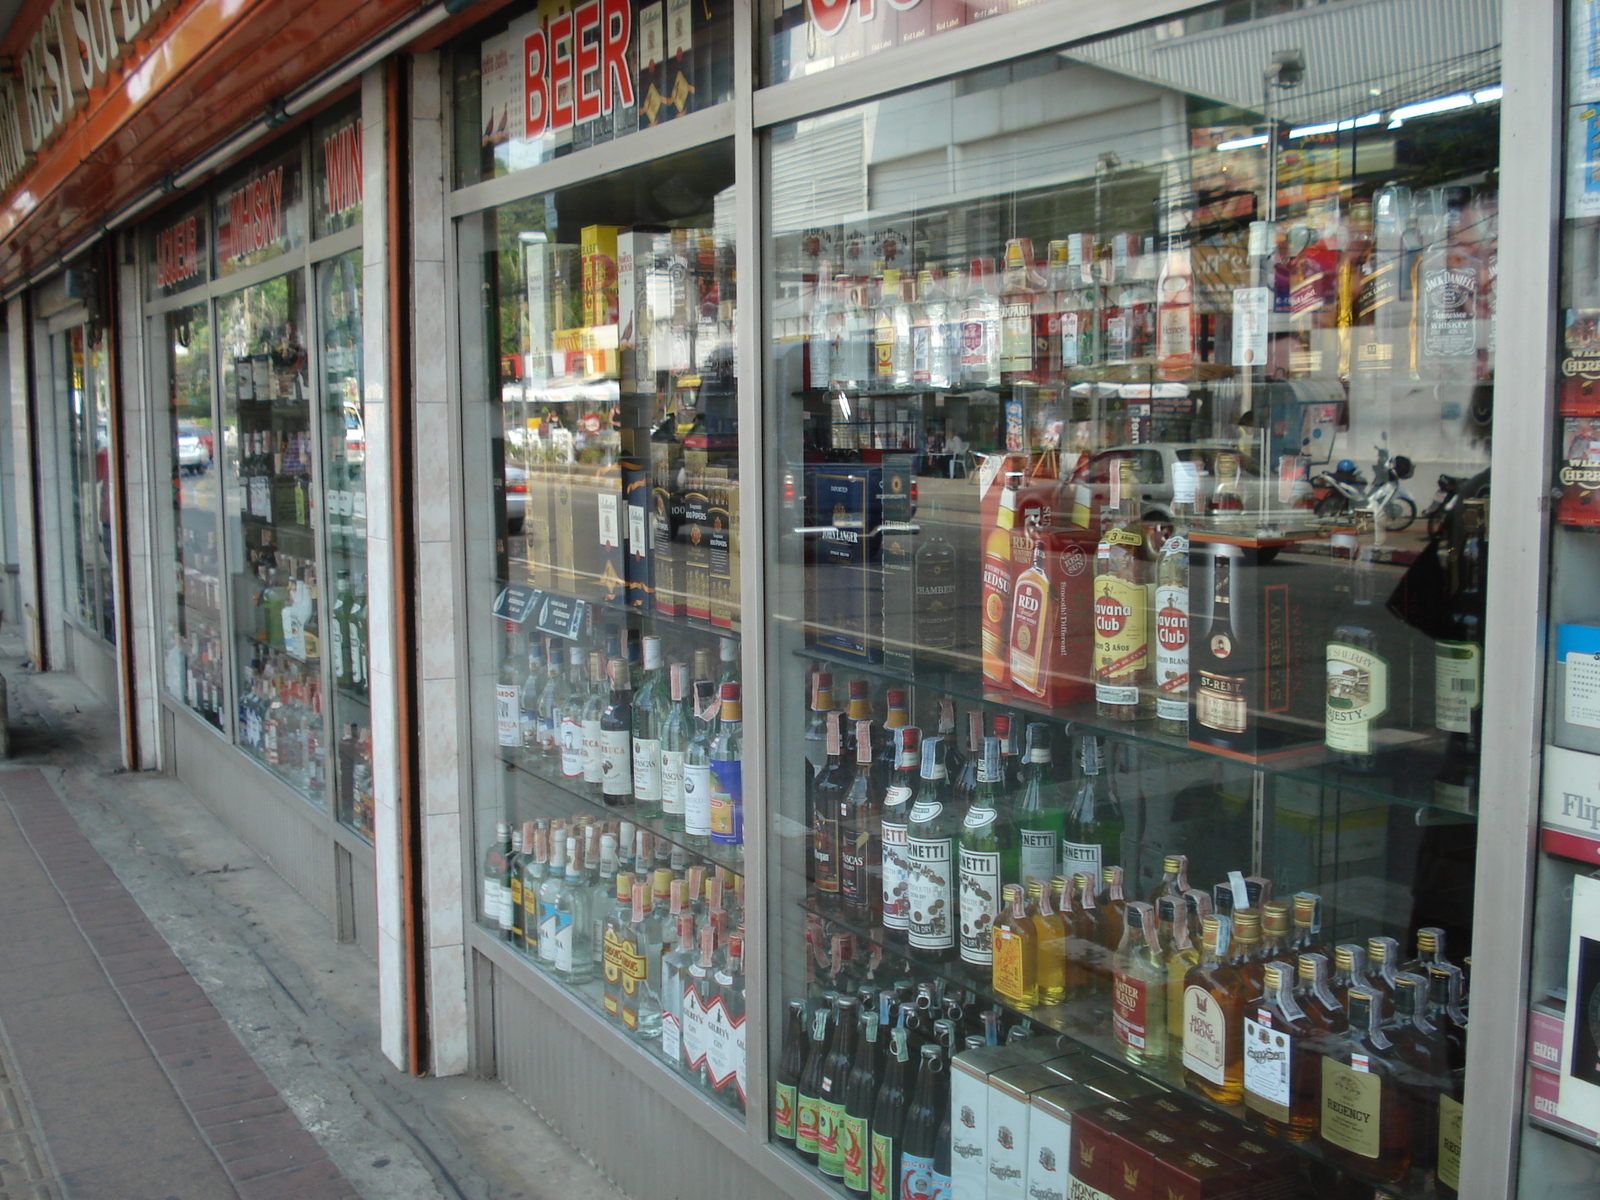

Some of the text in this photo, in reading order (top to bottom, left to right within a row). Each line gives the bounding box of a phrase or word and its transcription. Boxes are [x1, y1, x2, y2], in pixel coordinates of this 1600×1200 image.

[21, 0, 75, 153] BEST
[523, 0, 635, 142] BEER
[230, 165, 283, 259] WHISKY
[1372, 281, 1394, 295] LABEL
[1426, 271, 1477, 292] JACK DANIEL'S
[1431, 321, 1469, 330] WHISKEY
[671, 506, 686, 515] 100
[837, 529, 858, 544] LANGER
[1013, 536, 1034, 550] RED
[1110, 532, 1117, 541] 3
[1064, 552, 1083, 568] RED
[1068, 560, 1085, 575] SUN
[983, 570, 999, 587] RED
[1018, 594, 1039, 612] RED
[1096, 616, 1120, 631] Club
[1159, 628, 1186, 644] Club
[1104, 642, 1111, 652] 3
[1112, 643, 1130, 652] AÑOS
[1333, 648, 1376, 668] SHERRY
[1109, 663, 1121, 671] RON
[1173, 677, 1186, 686] RON
[684, 1007, 704, 1025] GILBEY'S
[1191, 1014, 1213, 1034] HONG
[688, 1024, 697, 1034] GIN
[708, 1021, 730, 1041] GILBEY'S
[1189, 1022, 1216, 1044] THONG
[713, 1039, 723, 1049] GIN
[1533, 1041, 1558, 1062] GIZEH
[1327, 1097, 1371, 1124] REGENCY
[1072, 1180, 1100, 1199] HONG
